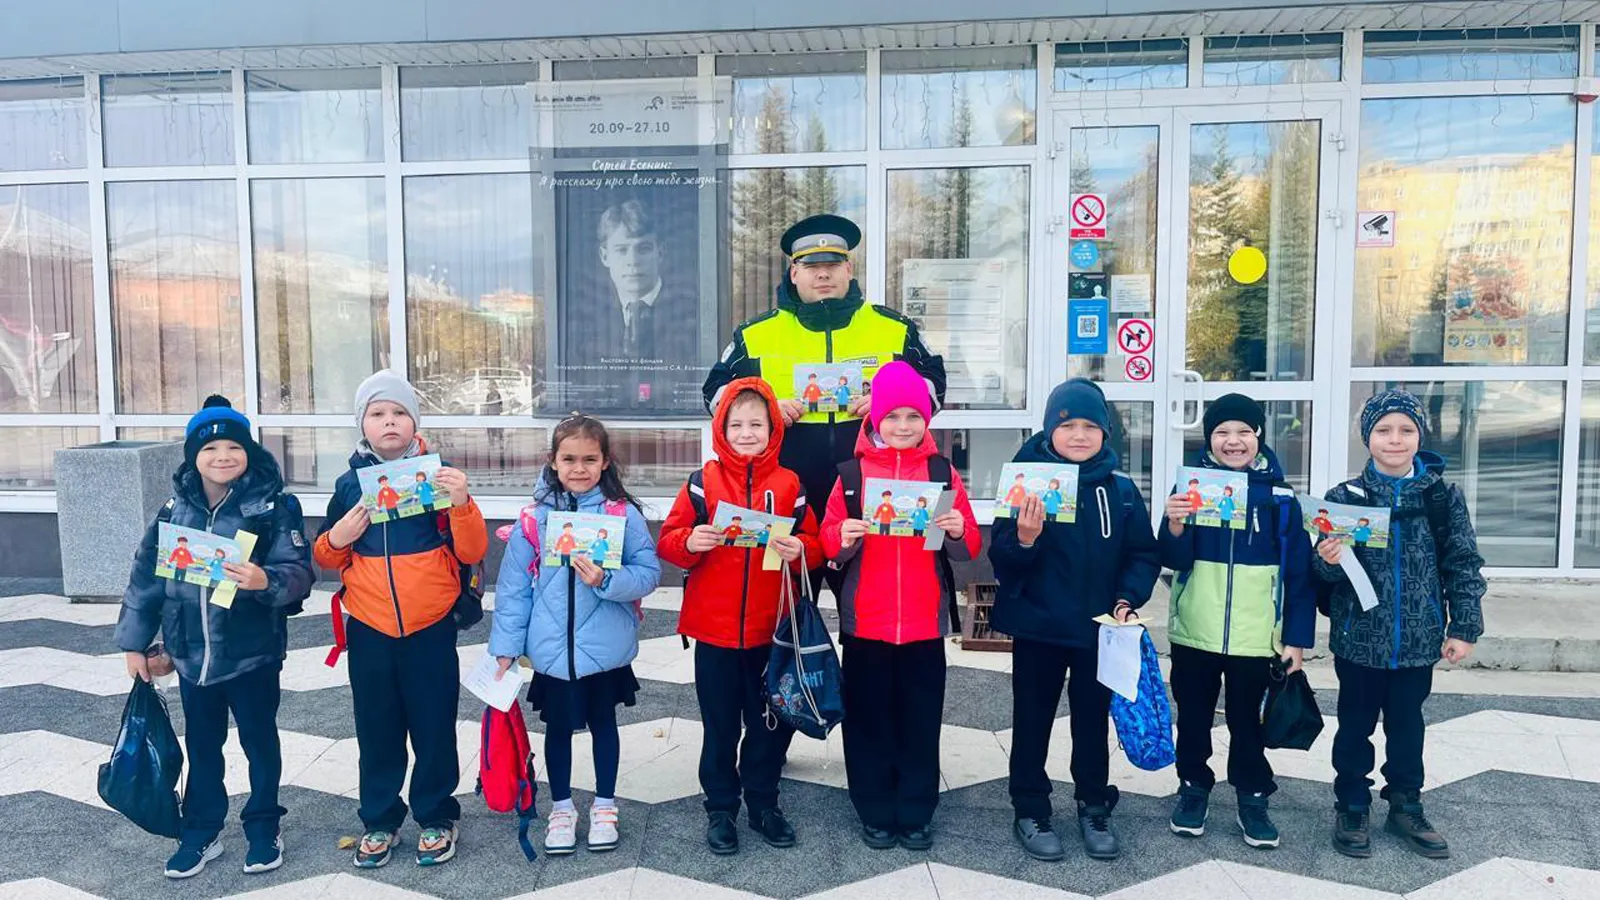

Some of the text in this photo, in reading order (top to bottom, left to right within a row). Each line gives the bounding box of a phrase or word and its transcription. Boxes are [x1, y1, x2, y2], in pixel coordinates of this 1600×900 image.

[590, 121, 670, 134] 20.09-27.10
[592, 158, 673, 173] Сергей Есенин:
[549, 177, 603, 191] расскажу
[604, 177, 625, 190] про
[627, 173, 653, 186] свою
[655, 172, 681, 185] тебе
